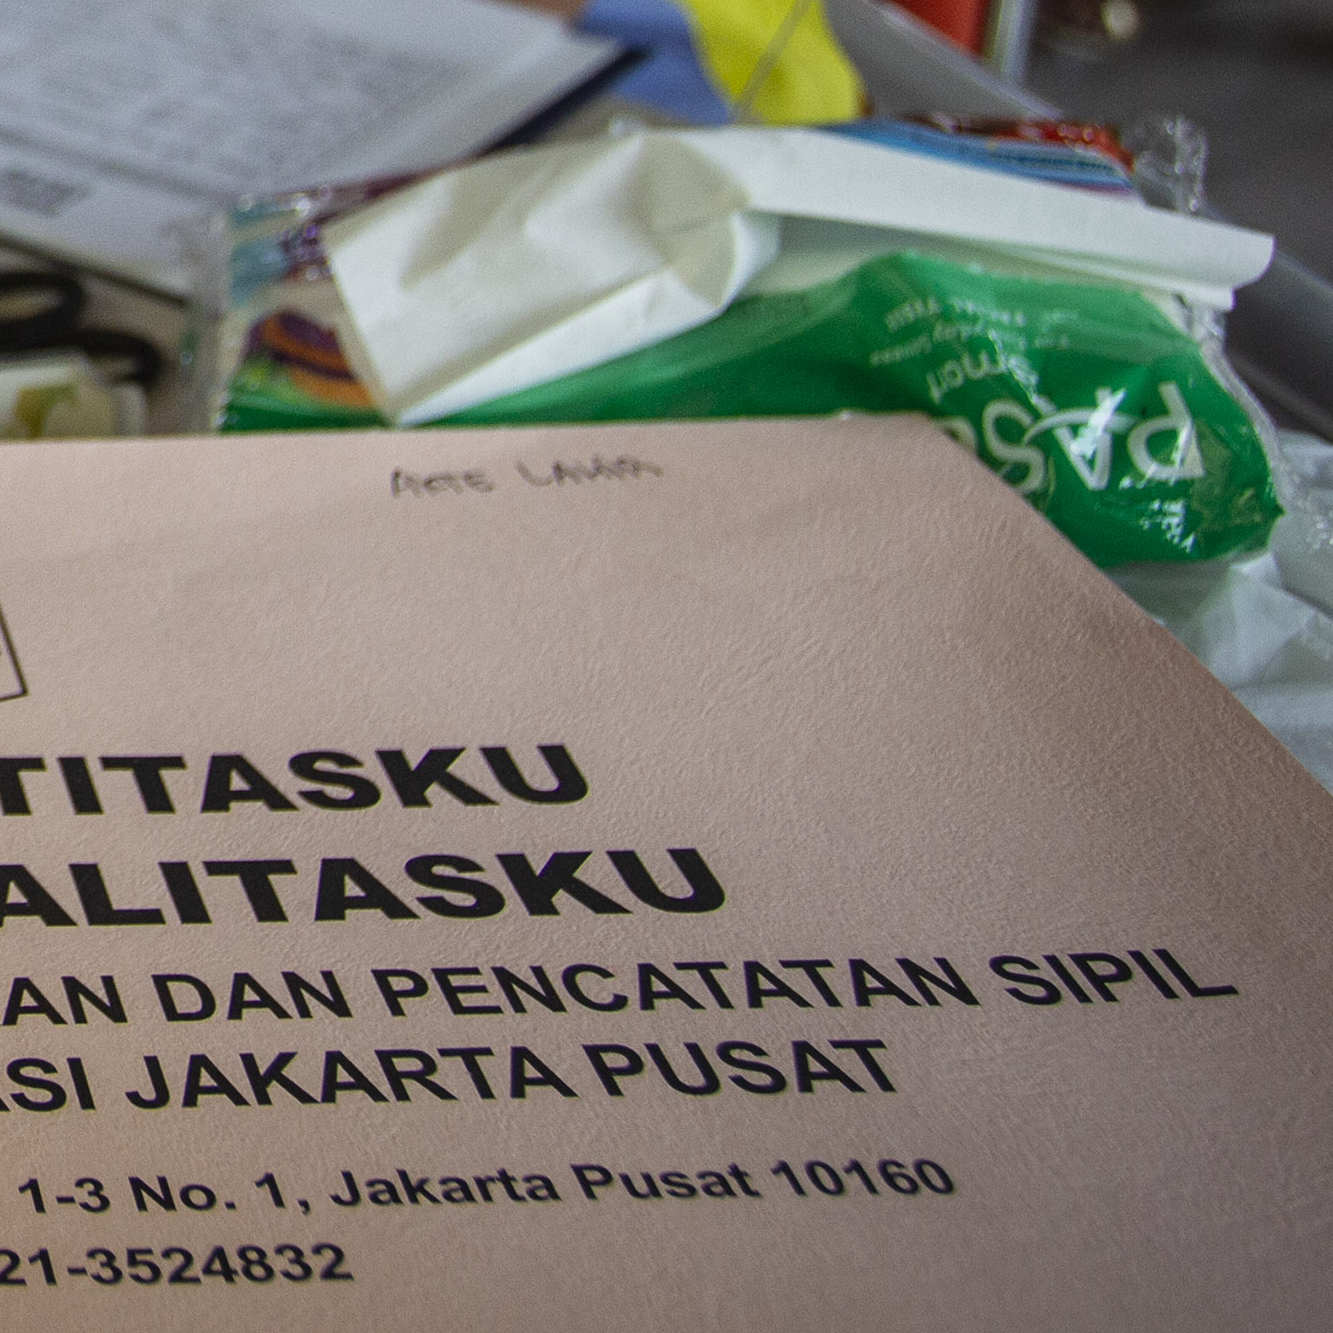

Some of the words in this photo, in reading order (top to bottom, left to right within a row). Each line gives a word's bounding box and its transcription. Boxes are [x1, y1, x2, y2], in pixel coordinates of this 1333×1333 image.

[151, 970, 353, 1022] DAN
[371, 957, 980, 1017] PENCATATAN
[989, 948, 1239, 1006] SIPIL
[125, 1046, 578, 1110] JAKARTA
[582, 1039, 896, 1097] PUSAT
[18, 1177, 111, 1214] 1-3
[128, 1175, 237, 1212] No.
[255, 1172, 311, 1215] 1,
[330, 1168, 561, 1207] Jakarta
[571, 1163, 762, 1201] Pusat
[771, 1158, 956, 1197] 10160
